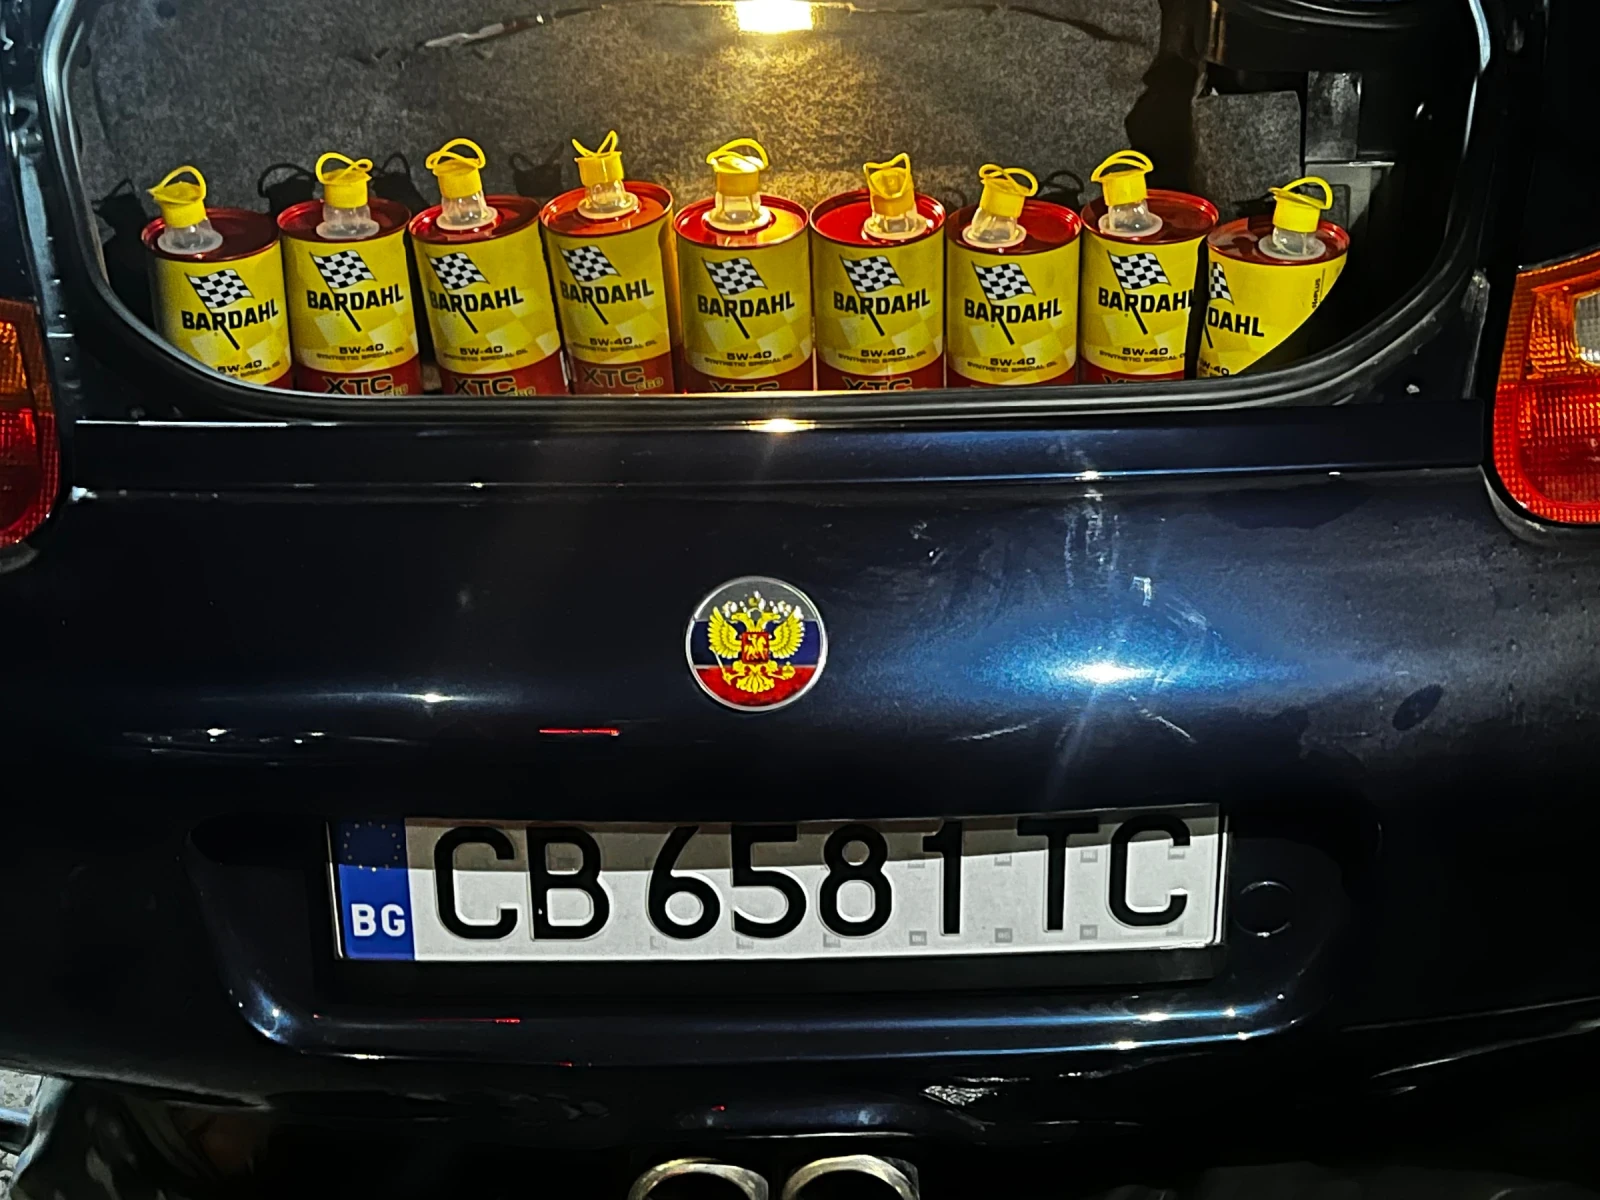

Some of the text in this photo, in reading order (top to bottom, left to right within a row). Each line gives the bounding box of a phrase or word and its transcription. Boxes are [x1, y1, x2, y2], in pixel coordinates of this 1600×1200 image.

[306, 283, 404, 312] BARDAHL
[429, 286, 524, 313] BARDAHL
[560, 278, 655, 304] BARDAHL
[833, 288, 931, 315] BARDAHL
[181, 298, 279, 331] BARDAHL
[697, 290, 795, 318] BARDAHL
[964, 297, 1062, 323] BARDAHL
[1207, 306, 1265, 337] DAHL
[339, 343, 384, 354] 5W-40
[459, 345, 503, 355] 5W-40
[589, 336, 633, 346] 5W-40
[860, 347, 906, 357] 5W-40
[1122, 347, 1168, 356] 5W-40
[726, 350, 772, 360] 5W-40
[989, 357, 1036, 367] 5W-40
[217, 359, 263, 374] 5W-40
[581, 366, 644, 387] XTC
[322, 373, 394, 395] XTC
[453, 375, 516, 396] XTC
[434, 813, 1191, 941] CB 6581 TC
[351, 903, 406, 938] BG
